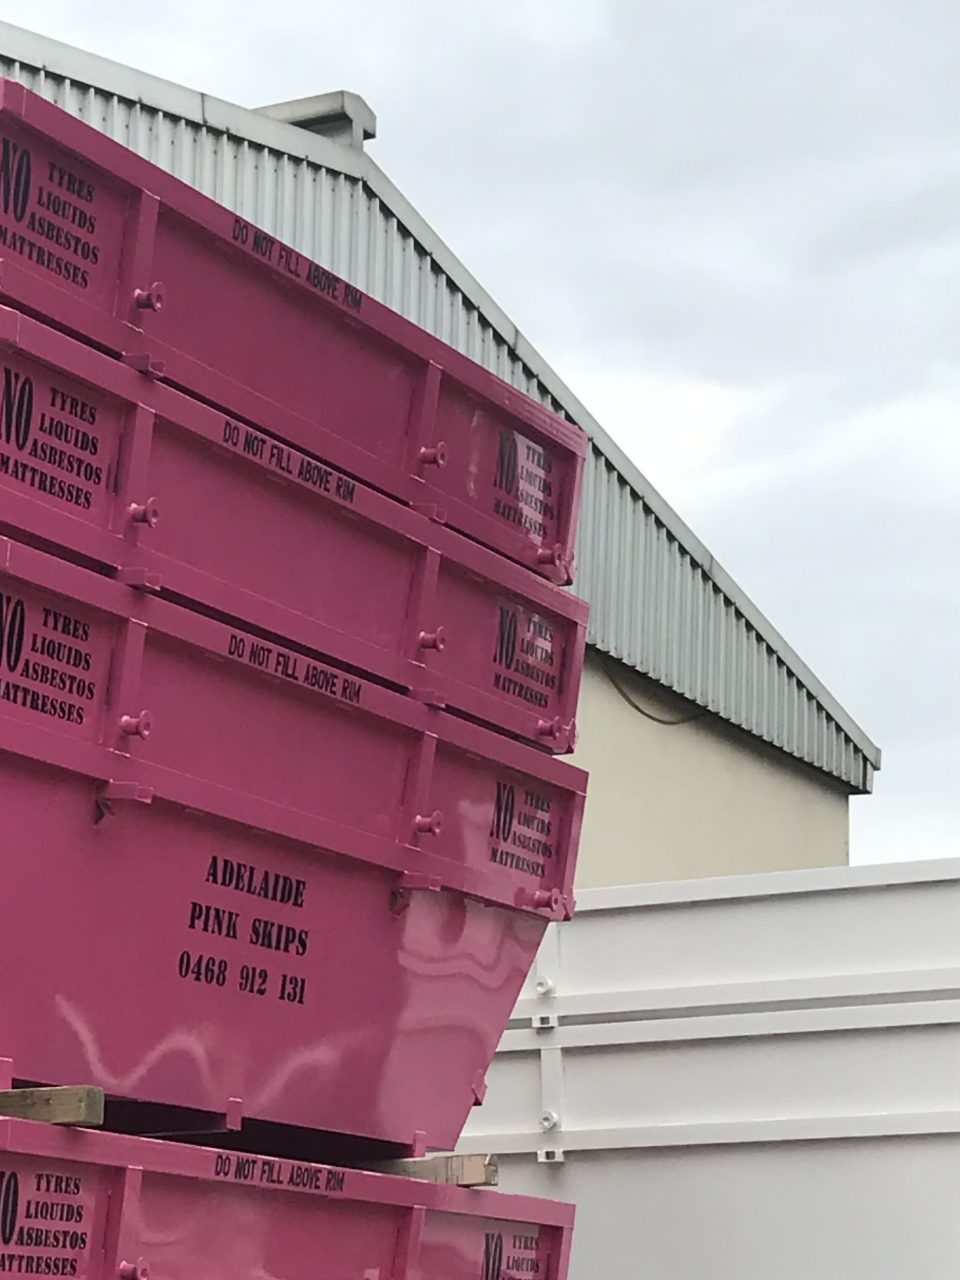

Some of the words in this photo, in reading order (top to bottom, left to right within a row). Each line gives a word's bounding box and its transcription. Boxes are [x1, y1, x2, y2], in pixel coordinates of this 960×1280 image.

[48, 162, 94, 202] TYRES
[37, 187, 95, 234] LIQUIDS
[27, 212, 99, 265] ASBESTOS
[50, 387, 96, 425] TYRES
[39, 413, 99, 456] LIQUIDS
[29, 439, 102, 486] ASBESTOS
[223, 421, 239, 447] DO
[243, 431, 266, 459] NOT
[269, 444, 293, 474] FILL
[298, 458, 332, 493] ABOVE
[336, 476, 355, 503] RIM
[42, 607, 90, 643] TYRES
[31, 633, 91, 671] LIQUIDS
[229, 634, 245, 658] DO
[249, 643, 272, 669] NOT
[275, 652, 298, 681] FILL
[303, 664, 338, 695] ABOVE
[341, 678, 362, 703] RIM
[20, 659, 95, 700] ASBESTOS
[490, 782, 514, 842] NO
[206, 856, 306, 907] ADELAIDE
[189, 902, 239, 939] PINK
[250, 918, 308, 956] SKIPS
[179, 951, 227, 986] 0468
[240, 965, 268, 995] 912
[279, 974, 305, 1004] 131
[35, 1173, 81, 1196] TYRES
[215, 1154, 231, 1176] DO
[235, 1157, 257, 1180] NOT
[260, 1160, 283, 1184] FILL
[288, 1165, 322, 1189] ABOVE
[325, 1170, 344, 1191] RIM
[25, 1200, 83, 1223] LIQUIDS
[15, 1226, 87, 1249] ASBESTOS
